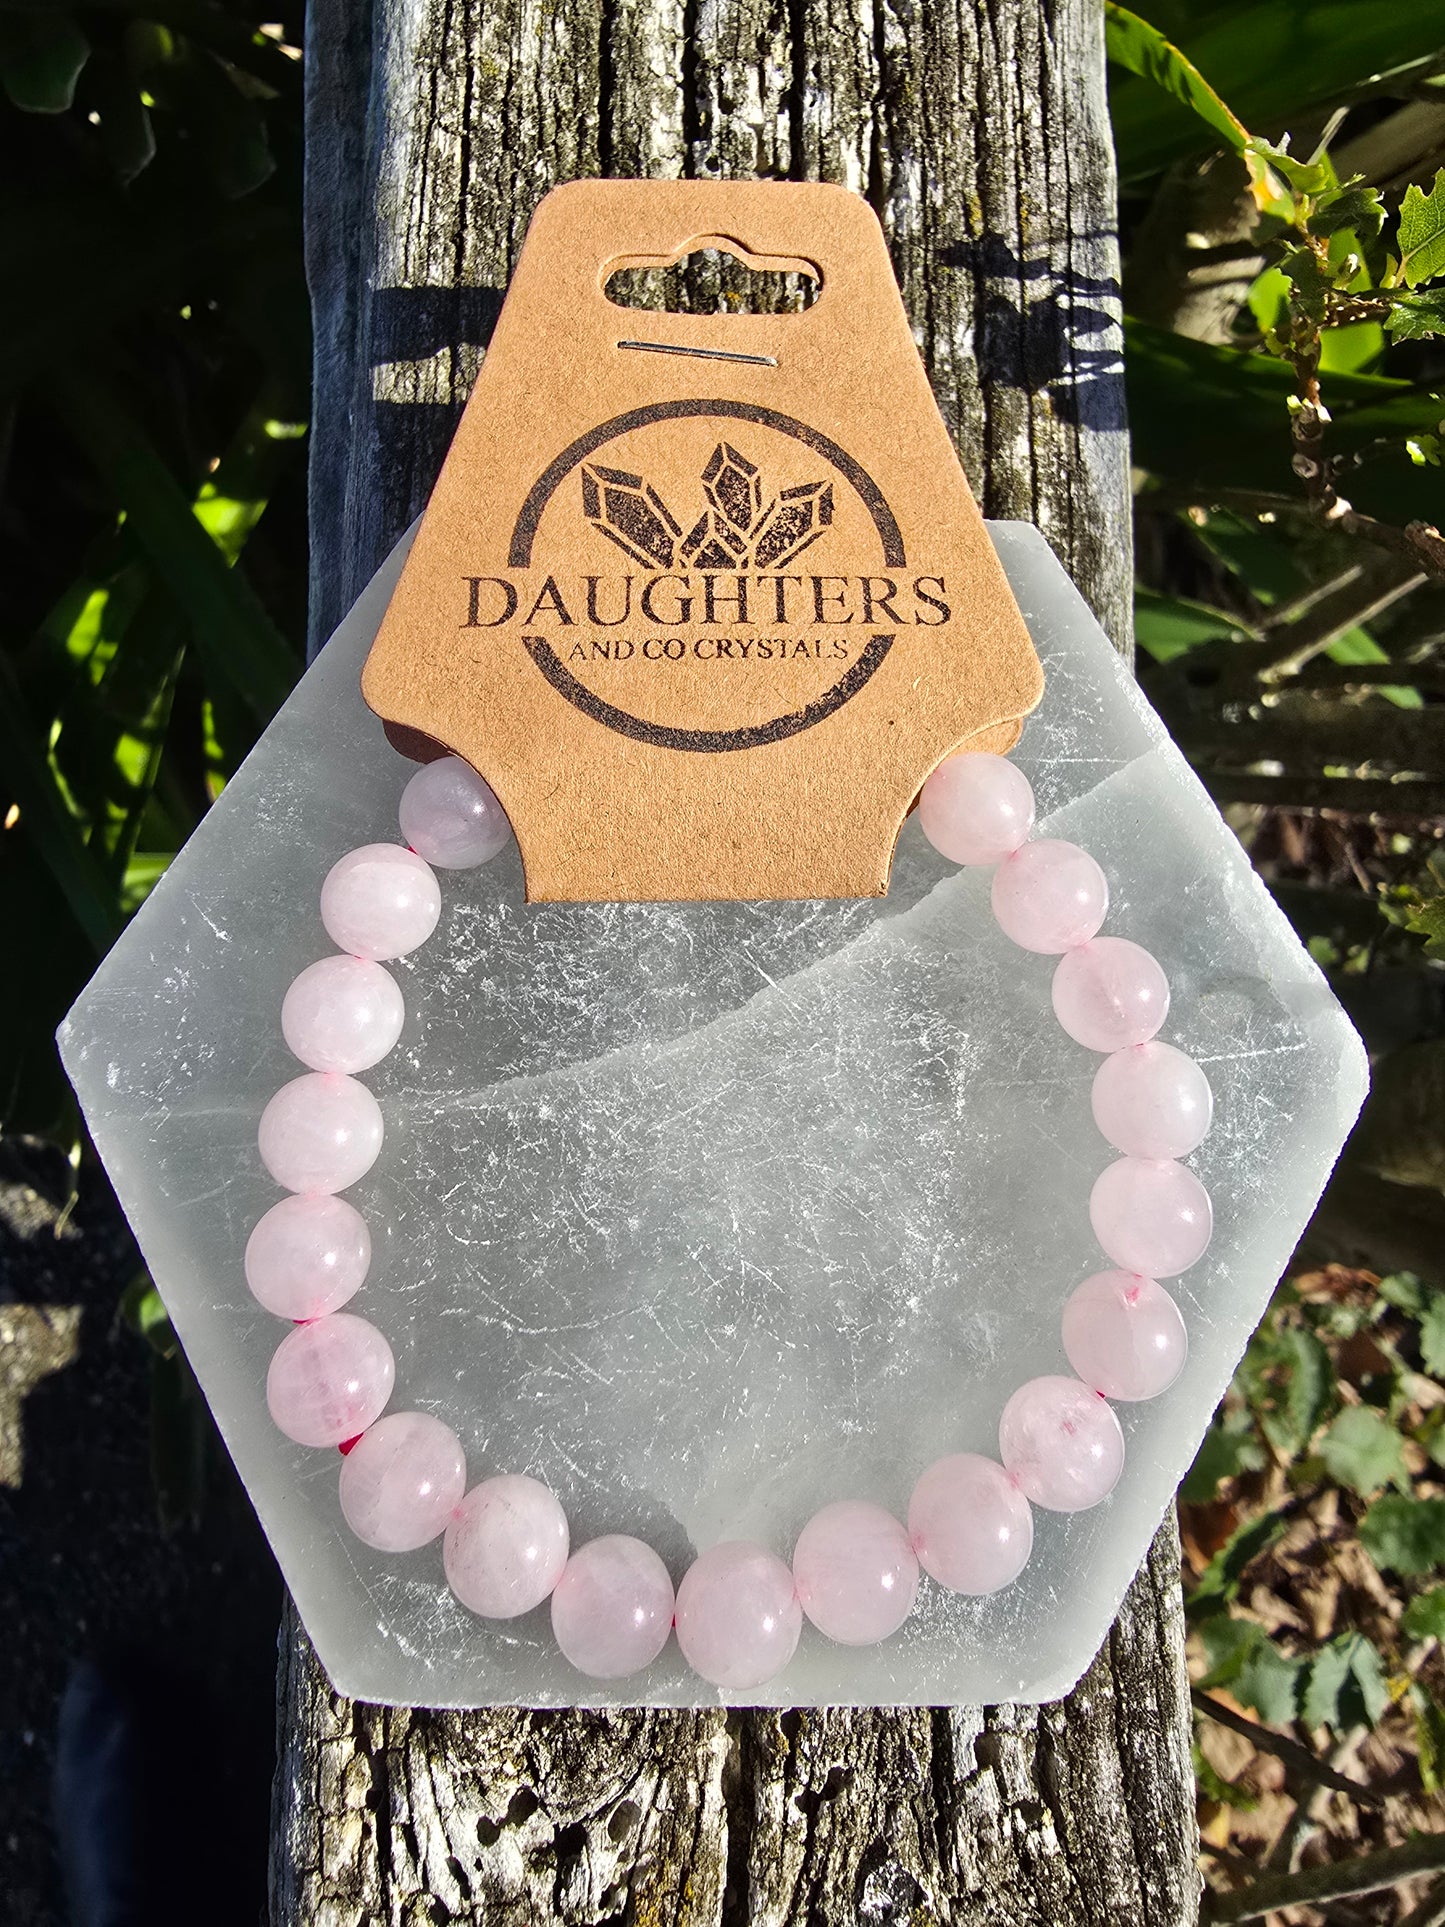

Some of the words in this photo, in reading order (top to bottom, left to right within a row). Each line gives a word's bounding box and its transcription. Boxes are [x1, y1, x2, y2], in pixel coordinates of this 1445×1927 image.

[458, 574, 952, 629] DAUGHTERS
[568, 639, 635, 662] AND
[642, 638, 686, 661] CO
[693, 637, 849, 661] CRYSTALS
